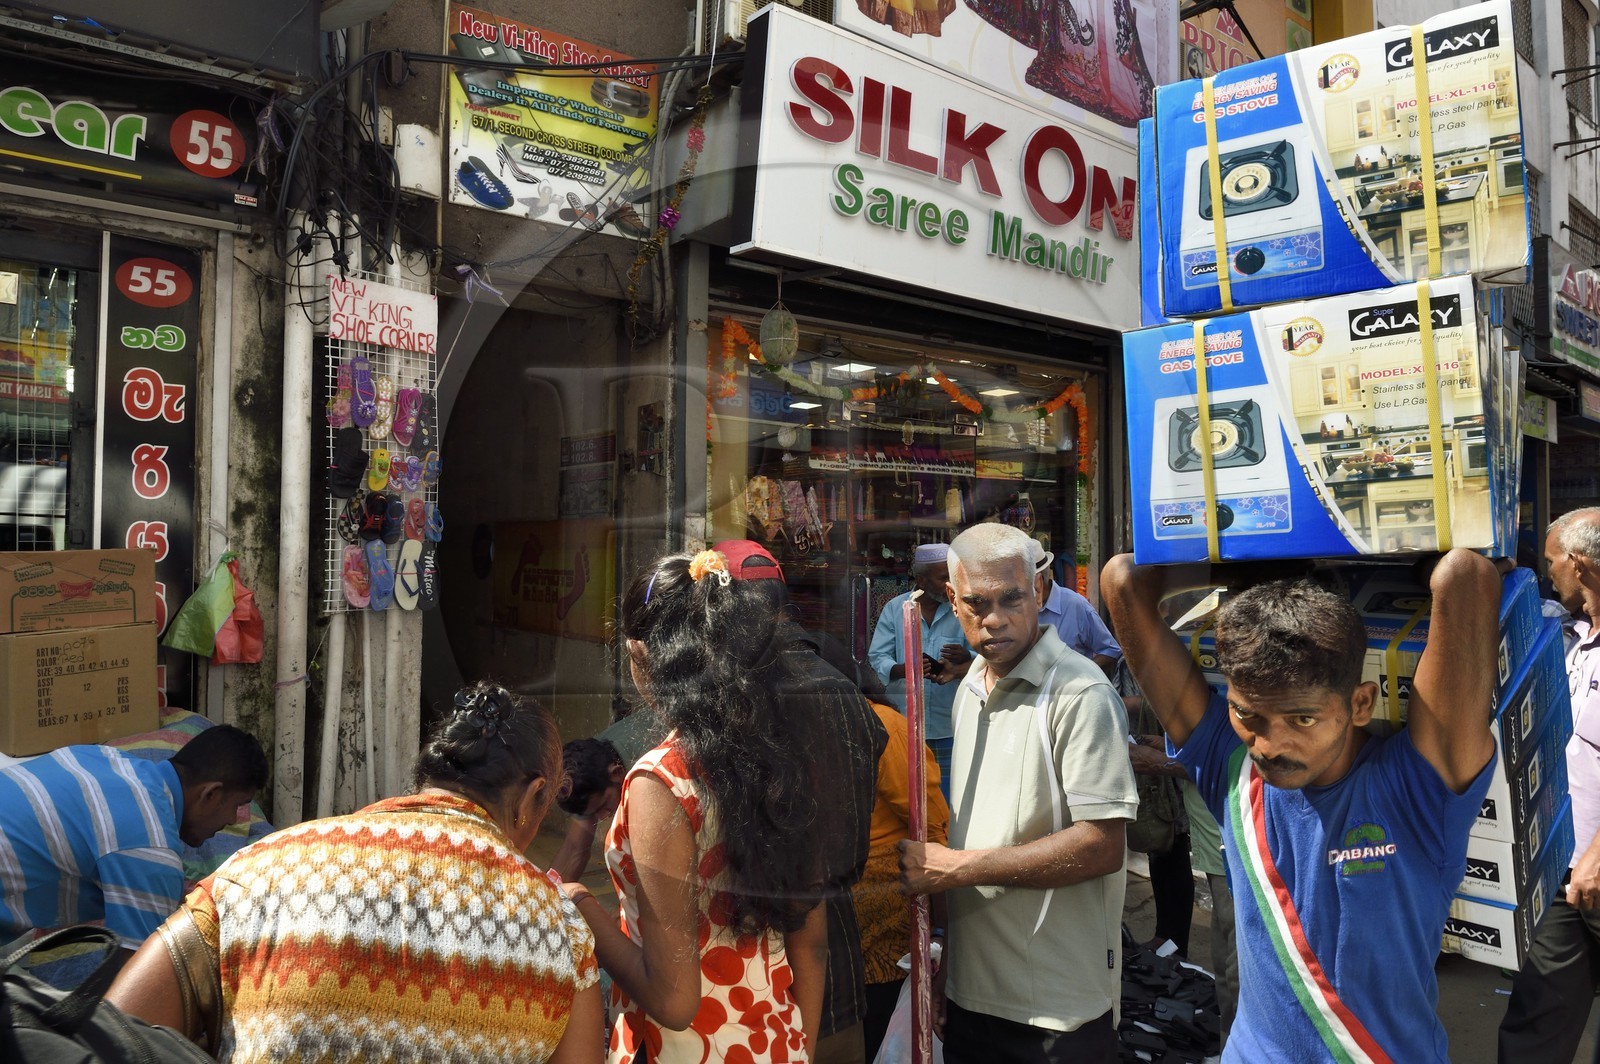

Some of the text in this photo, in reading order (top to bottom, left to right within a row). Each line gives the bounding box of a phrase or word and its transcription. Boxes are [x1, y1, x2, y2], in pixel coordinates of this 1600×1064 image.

[460, 11, 497, 43] New
[501, 23, 559, 65] Vi-King
[1321, 64, 1330, 89] 1
[1235, 82, 1277, 99] SAVING
[497, 80, 624, 122] Importers & Wholesale
[1193, 94, 1278, 123] GS STOVE
[1453, 102, 1476, 113] steel
[468, 84, 648, 139] Dealers in All Kinds of Footwear
[490, 108, 520, 121] MARKET
[186, 120, 233, 170] 55
[472, 115, 497, 132] 57/1,
[498, 121, 535, 140] SECOND
[536, 131, 566, 148] CROSS
[568, 139, 600, 157] STREET,
[523, 152, 545, 164] MOB
[524, 144, 537, 153] TEL
[784, 56, 1137, 241] SILK ON
[548, 166, 565, 176] 077
[829, 163, 1114, 285] Saree Mandir
[128, 265, 177, 297] 55
[332, 278, 366, 297] NEW
[332, 291, 412, 330] VI-KING
[1373, 307, 1394, 317] Super
[331, 313, 436, 354] SHOE CORNER
[1285, 326, 1296, 351] 1
[1351, 344, 1368, 354] your
[1369, 341, 1383, 349] best
[1406, 337, 1417, 347] for
[1436, 332, 1463, 343] quality
[1161, 352, 1243, 374] GAS TOVE
[1373, 383, 1414, 394] Stainless
[1374, 400, 1391, 409] Use
[1163, 517, 1191, 526] GALAXY
[37, 647, 49, 657] ART
[37, 656, 59, 667] COLOR:
[37, 668, 53, 677] SIZE:
[54, 667, 63, 675] 39
[66, 665, 75, 673] 40
[121, 657, 129, 665] 45
[37, 678, 54, 688] ASST
[37, 688, 51, 698] QTY:
[83, 682, 91, 692] 12
[73, 713, 78, 722] X
[83, 712, 93, 721] 39
[97, 709, 102, 718] X
[106, 707, 116, 716] 32
[121, 704, 130, 713] CM
